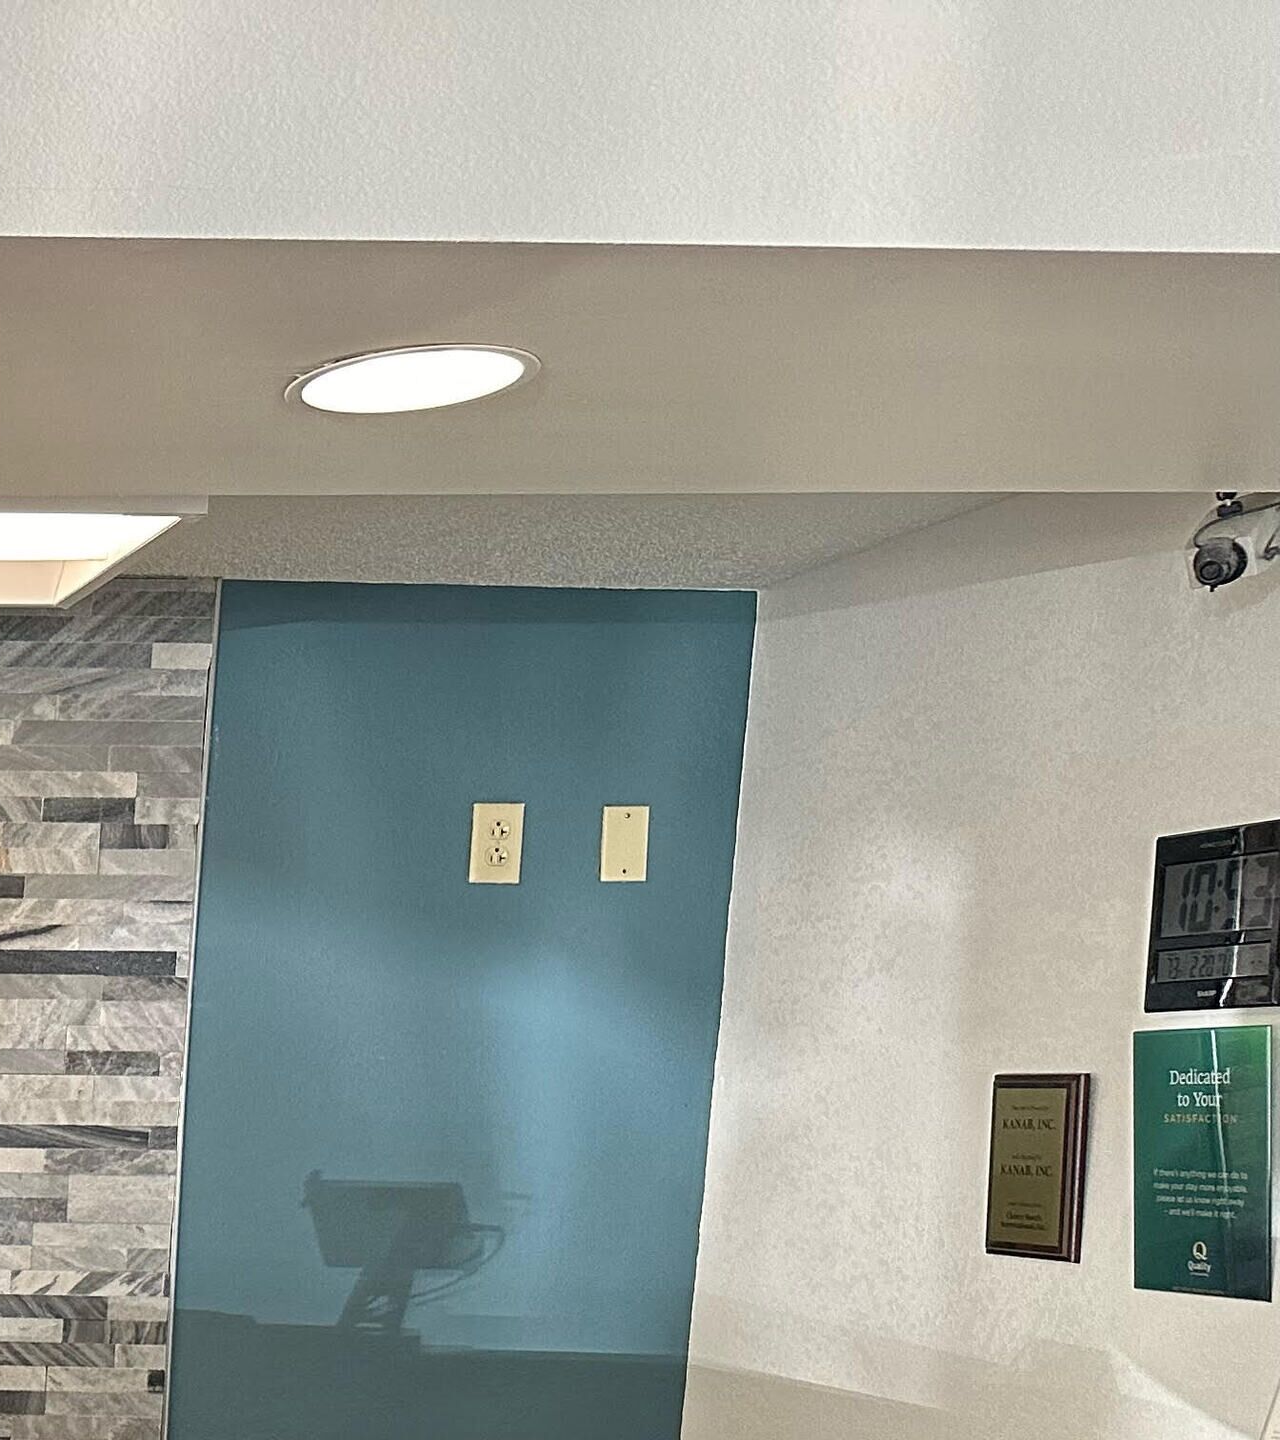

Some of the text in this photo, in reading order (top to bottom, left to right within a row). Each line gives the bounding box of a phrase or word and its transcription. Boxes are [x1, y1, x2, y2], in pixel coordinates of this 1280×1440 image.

[1168, 1067, 1231, 1085] Dedicated
[1176, 1091, 1223, 1107] to Your
[1163, 1113, 1239, 1124] SATISFACTON
